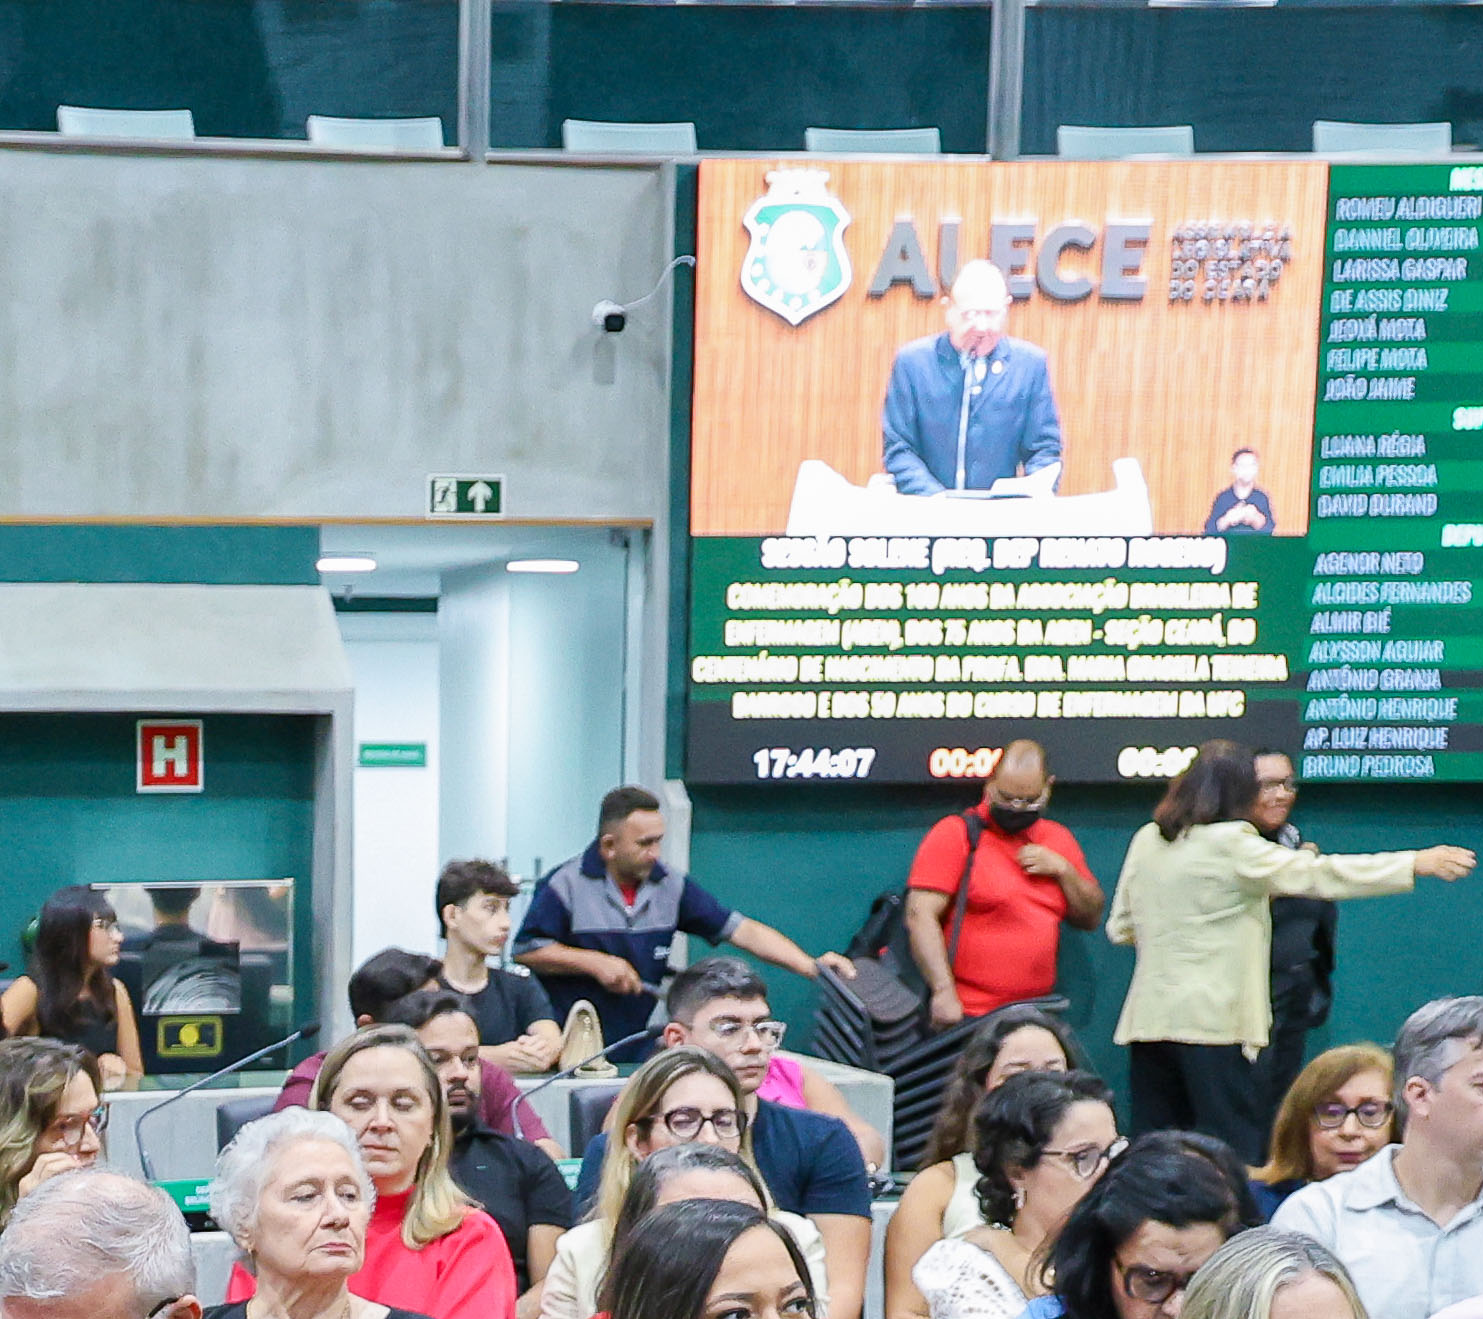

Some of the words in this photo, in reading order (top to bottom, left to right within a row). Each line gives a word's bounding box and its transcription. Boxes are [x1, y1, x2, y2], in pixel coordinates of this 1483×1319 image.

[1355, 289, 1402, 311] ASSIS
[1318, 494, 1368, 517] DAVID
[1381, 552, 1423, 574] NETO
[151, 735, 188, 777] H
[754, 748, 875, 778] 17:44:07
